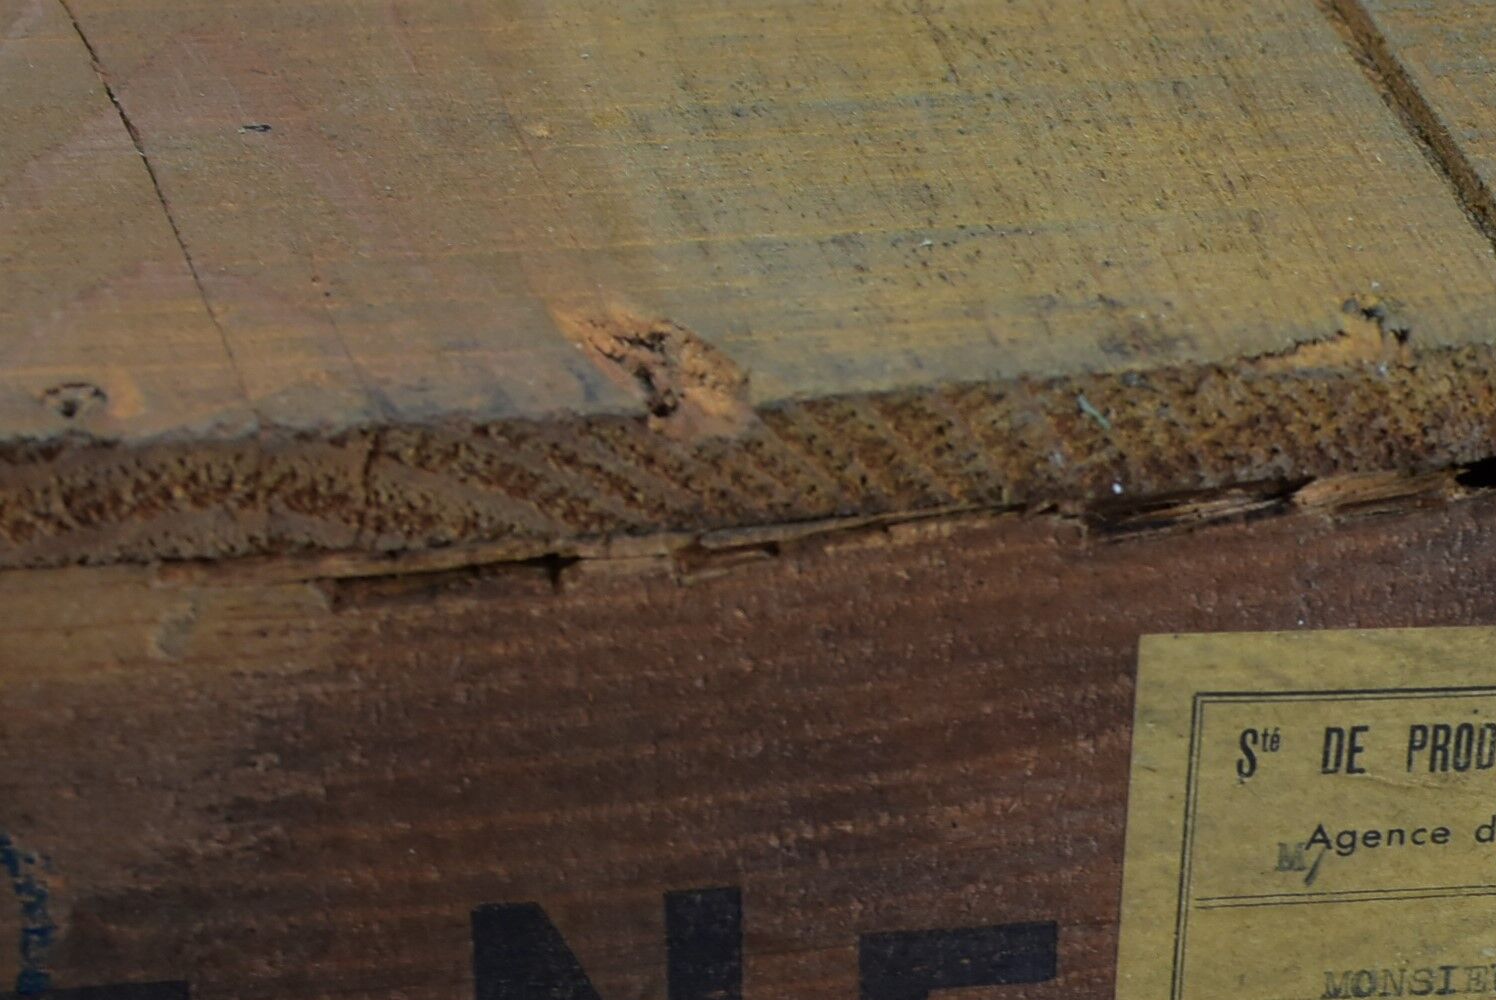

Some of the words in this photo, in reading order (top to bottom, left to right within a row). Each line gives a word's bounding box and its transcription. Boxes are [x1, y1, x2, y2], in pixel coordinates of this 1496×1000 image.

[1236, 726, 1281, 779] Sté
[1321, 725, 1370, 775] DE
[1305, 824, 1451, 857] Agence
